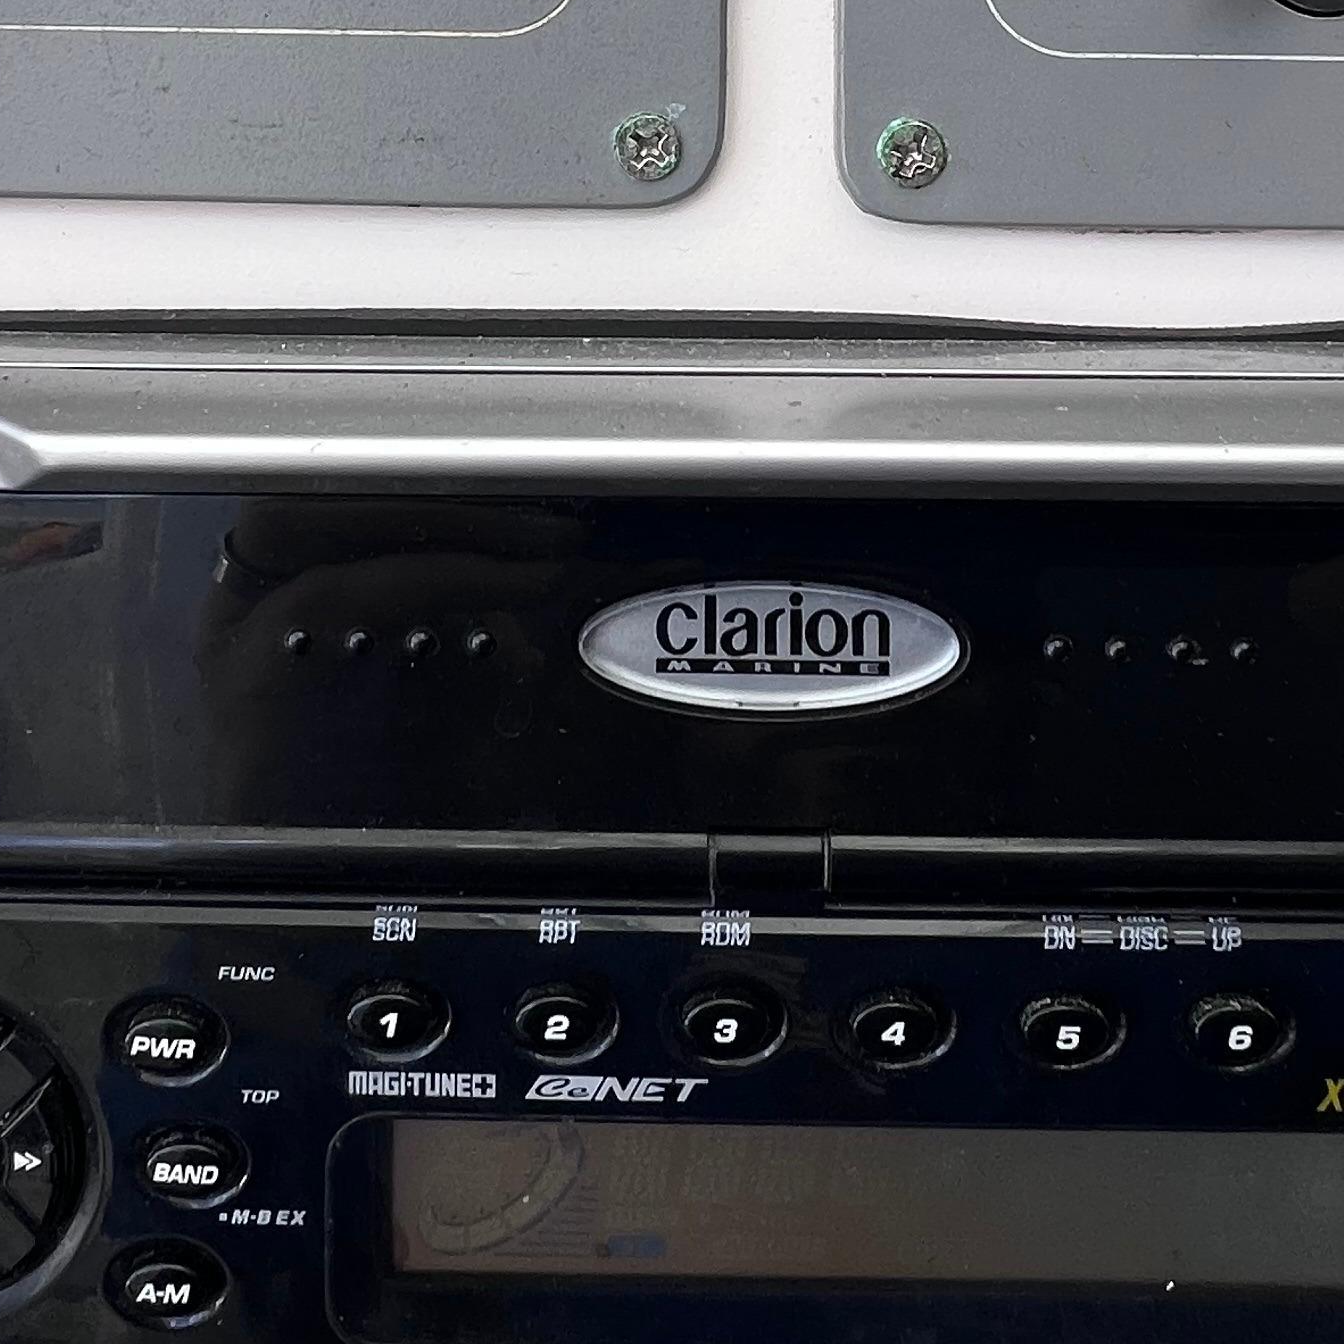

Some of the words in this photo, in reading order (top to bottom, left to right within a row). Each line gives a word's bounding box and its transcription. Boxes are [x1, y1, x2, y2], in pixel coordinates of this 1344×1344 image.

[666, 659, 881, 675] MARINE
[1119, 925, 1169, 951] DISC
[217, 965, 276, 982] FUNC
[378, 1011, 400, 1039] 1
[543, 1014, 570, 1041] 2
[712, 1017, 739, 1043] 3
[880, 1021, 906, 1046] 4
[1056, 1025, 1082, 1050] 5
[1227, 1025, 1254, 1050] 6
[130, 1035, 196, 1060] PWR
[241, 1089, 280, 1104] TOP
[152, 1164, 219, 1185] BAND
[275, 1209, 306, 1226] EX
[136, 1284, 190, 1305] A-M
